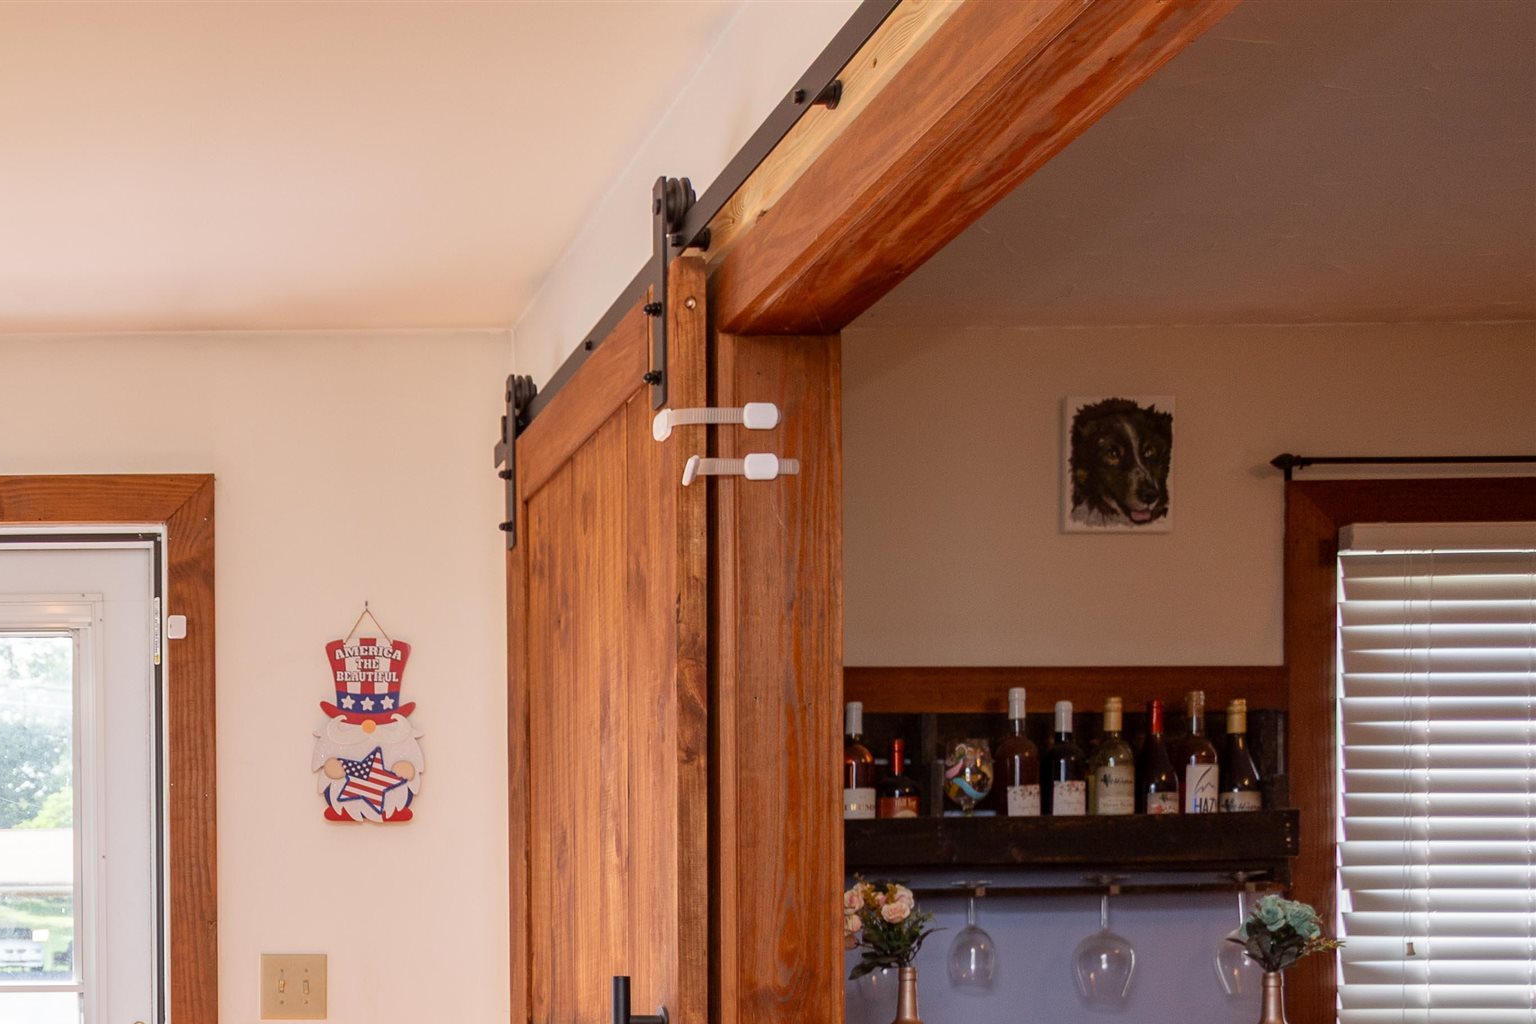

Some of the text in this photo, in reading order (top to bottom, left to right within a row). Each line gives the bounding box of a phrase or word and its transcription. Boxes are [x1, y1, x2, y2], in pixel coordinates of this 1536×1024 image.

[335, 645, 402, 661] AMERICA
[356, 659, 379, 670] THE
[336, 671, 399, 682] BEAUTIFUL
